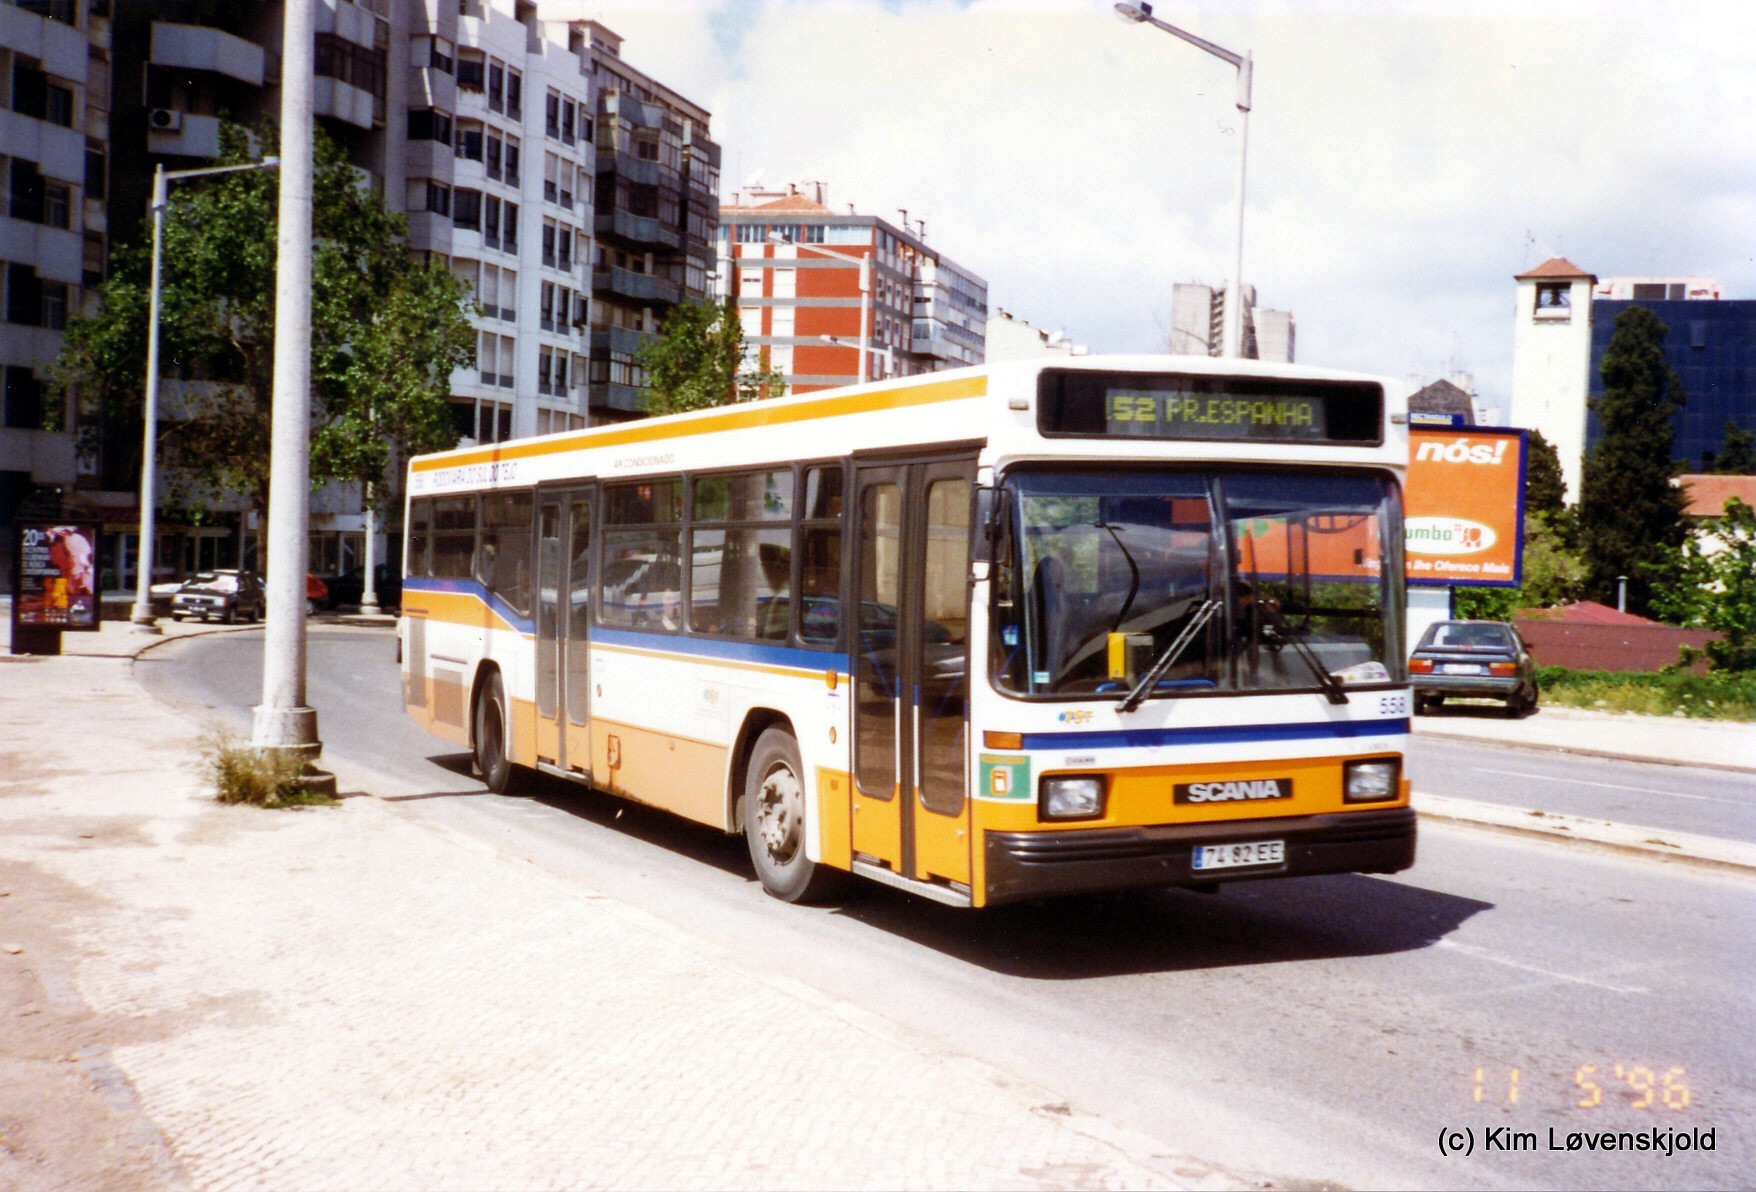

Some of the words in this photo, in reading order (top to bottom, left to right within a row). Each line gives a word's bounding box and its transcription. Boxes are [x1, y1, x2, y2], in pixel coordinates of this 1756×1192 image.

[1415, 438, 1508, 464] nós!
[1405, 525, 1453, 541] umbo
[1188, 780, 1281, 802] SCANIA
